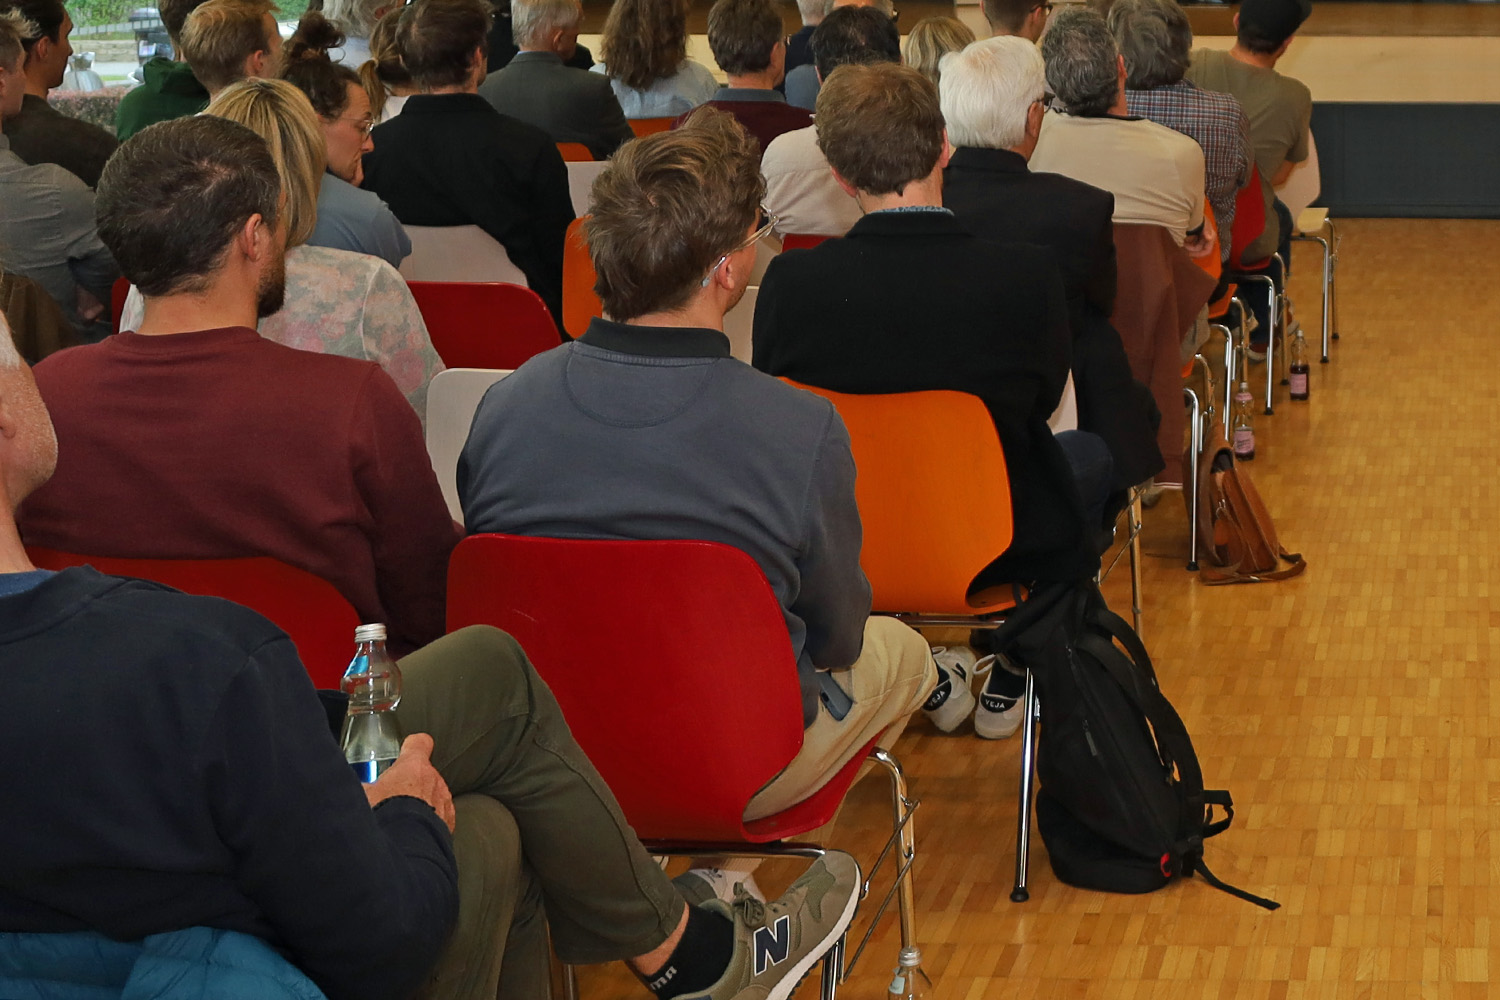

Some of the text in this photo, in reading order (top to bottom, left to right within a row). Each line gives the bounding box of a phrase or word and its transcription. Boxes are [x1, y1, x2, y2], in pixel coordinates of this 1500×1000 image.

[927, 690, 946, 707] VEJA
[984, 699, 1006, 709] VEJA
[753, 914, 790, 977] N
